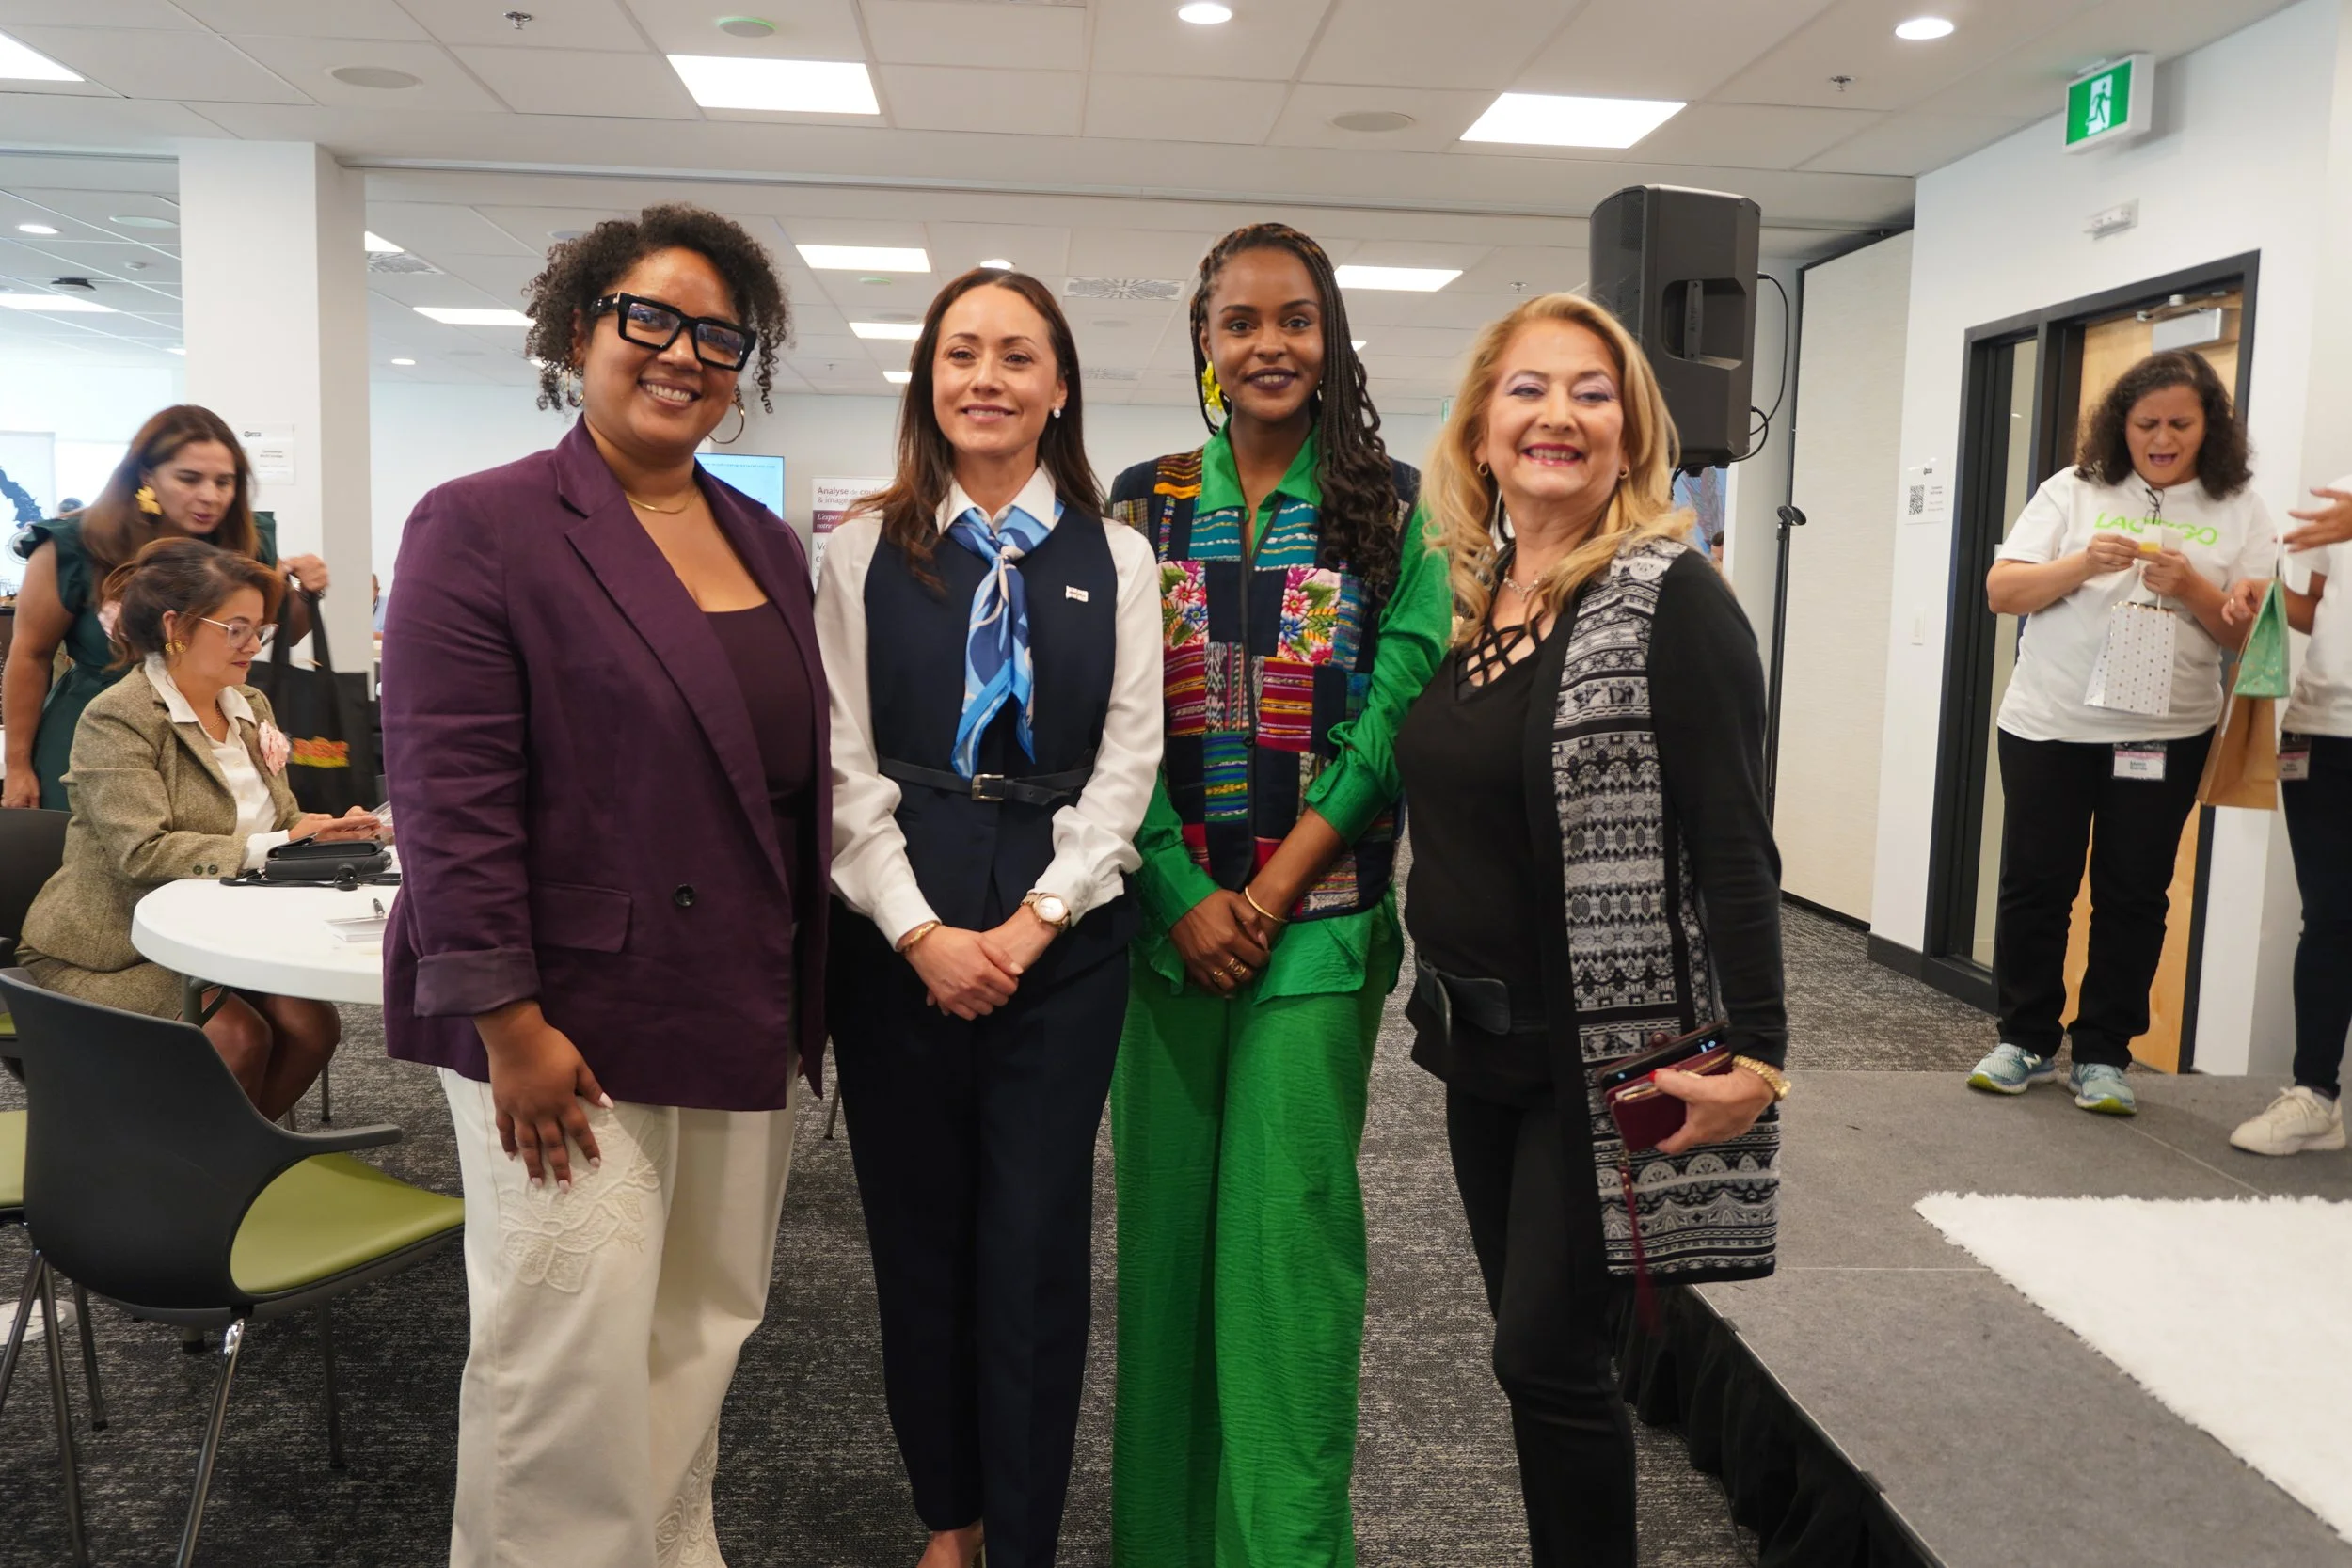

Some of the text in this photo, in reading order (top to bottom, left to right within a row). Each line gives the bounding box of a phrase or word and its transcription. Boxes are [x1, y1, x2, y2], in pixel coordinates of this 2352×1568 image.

[817, 486, 849, 498] Analyse
[860, 487, 881, 496] coul
[825, 497, 848, 506] image
